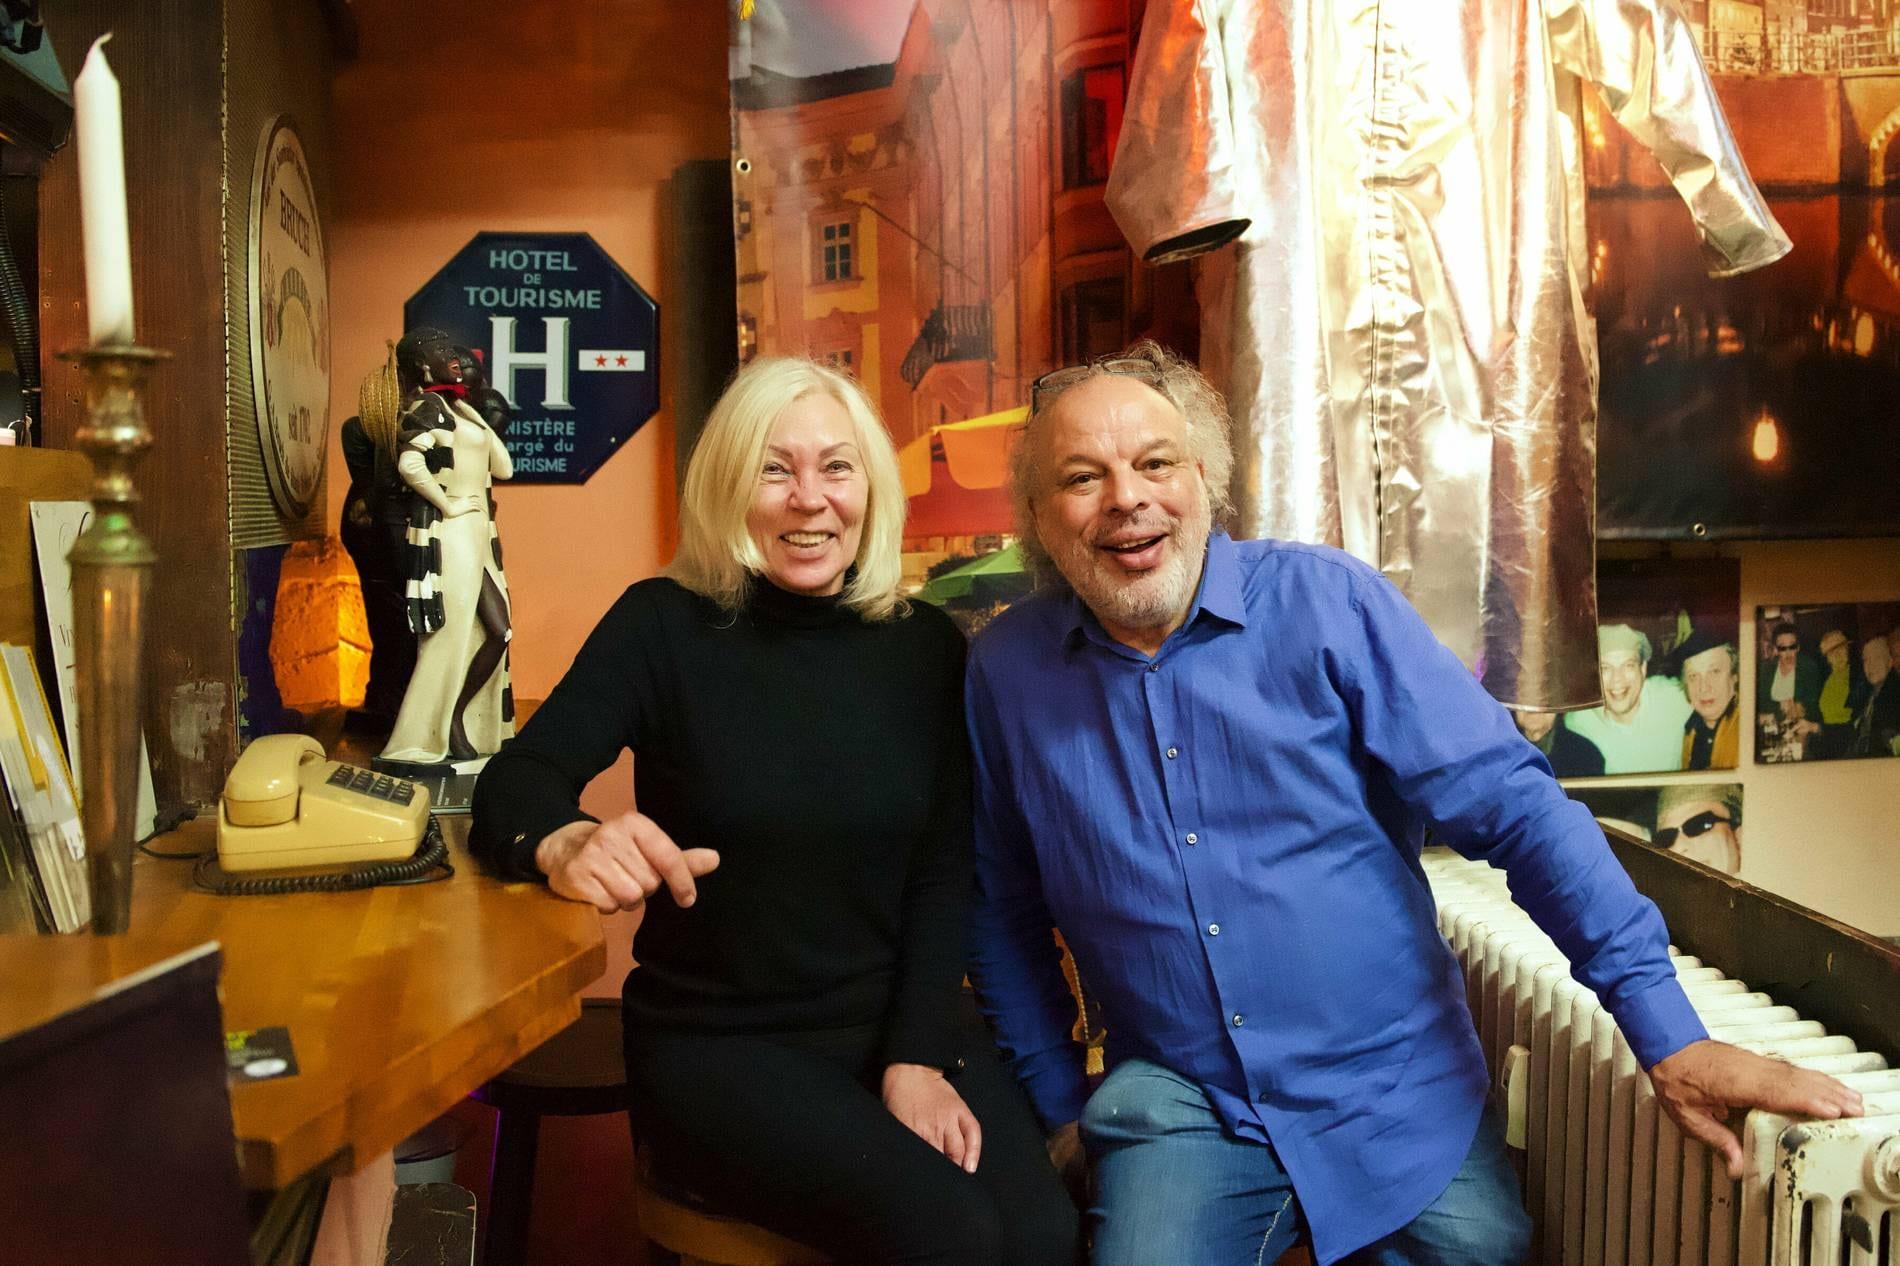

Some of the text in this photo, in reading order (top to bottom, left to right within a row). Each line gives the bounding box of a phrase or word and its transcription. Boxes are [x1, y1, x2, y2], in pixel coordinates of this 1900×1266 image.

[280, 188, 310, 257] BRUCH
[489, 250, 578, 271] HOTEL
[523, 273, 541, 285] DE
[464, 286, 601, 309] TOURISME
[488, 316, 576, 410] H
[505, 417, 576, 436] NISTÈRE
[507, 437, 574, 456] argé du
[512, 457, 567, 472] URISME
